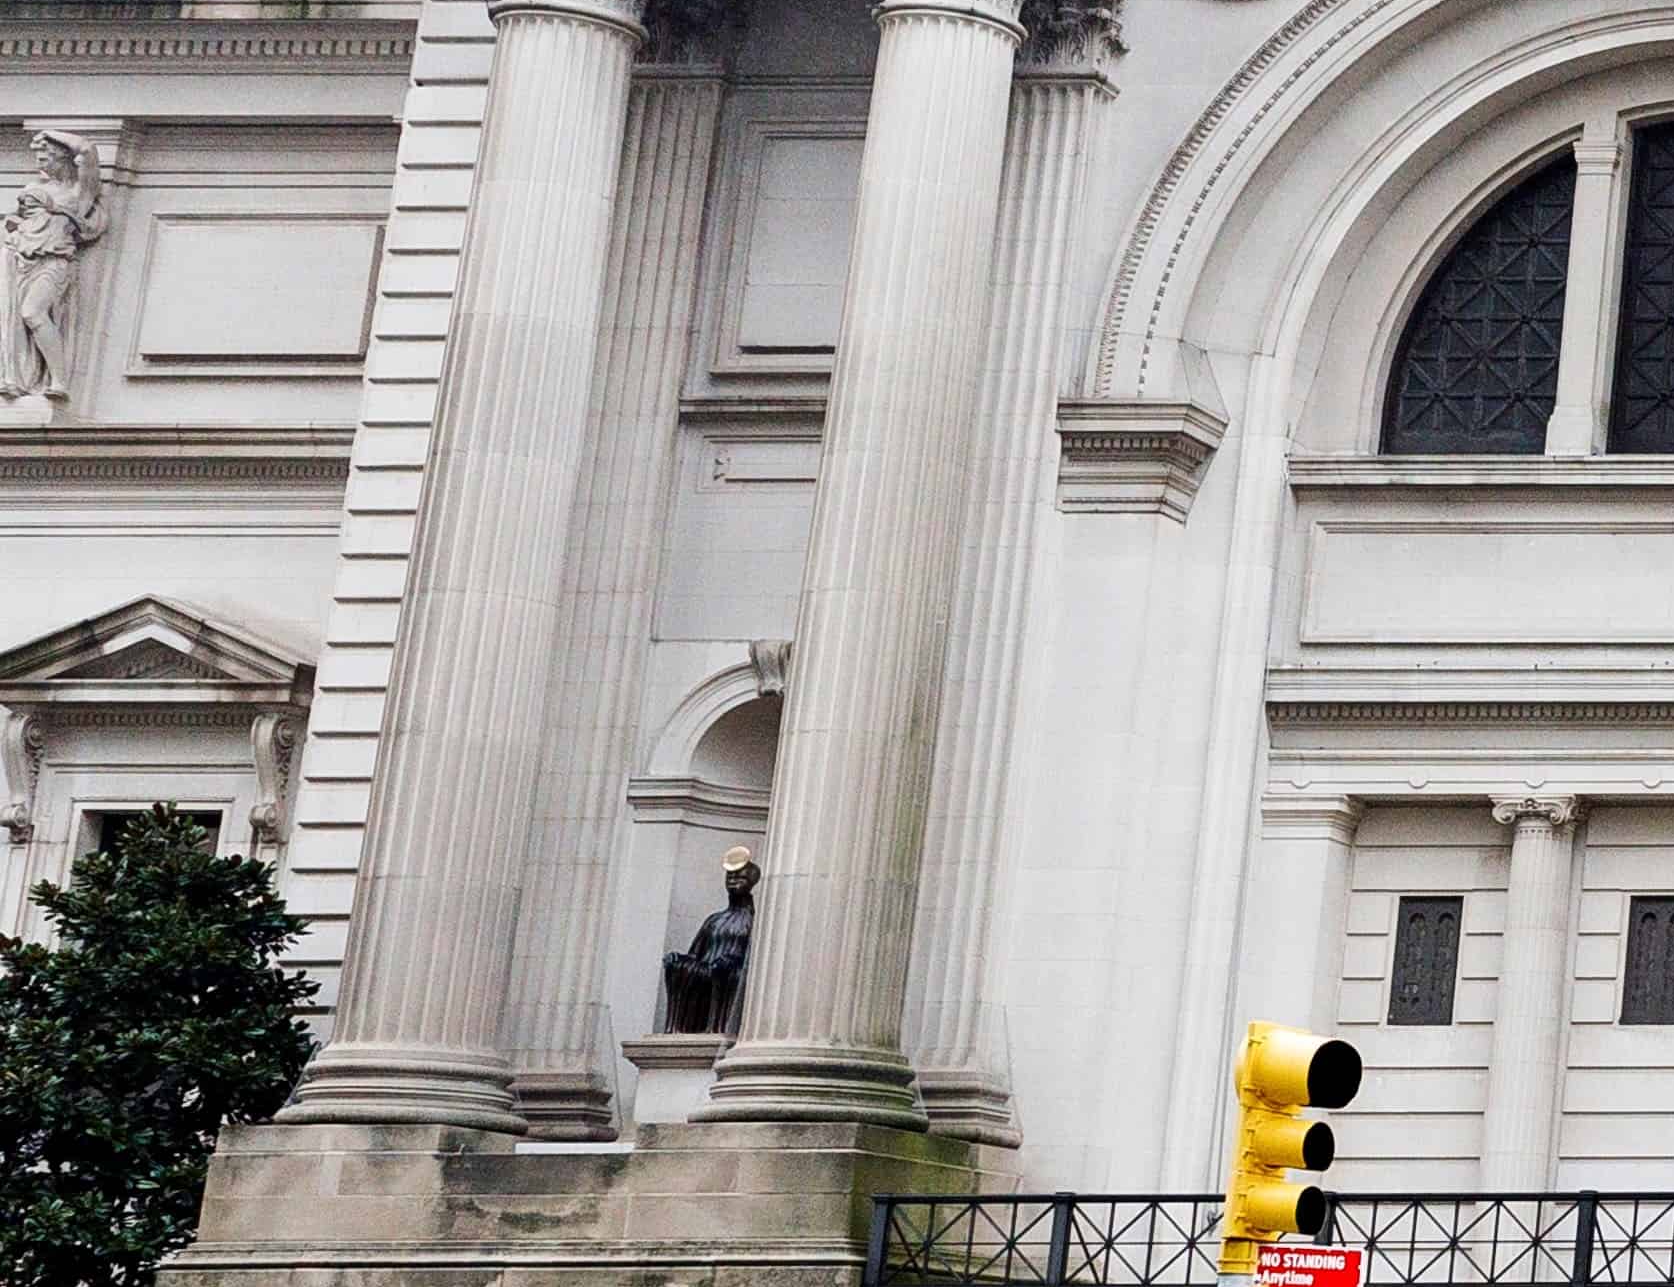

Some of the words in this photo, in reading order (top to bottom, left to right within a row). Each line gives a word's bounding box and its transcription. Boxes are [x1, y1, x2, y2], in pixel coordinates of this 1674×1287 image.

[1262, 1253, 1280, 1267] NO
[1284, 1254, 1345, 1270] STANDING
[1261, 1271, 1314, 1287] Anytime
